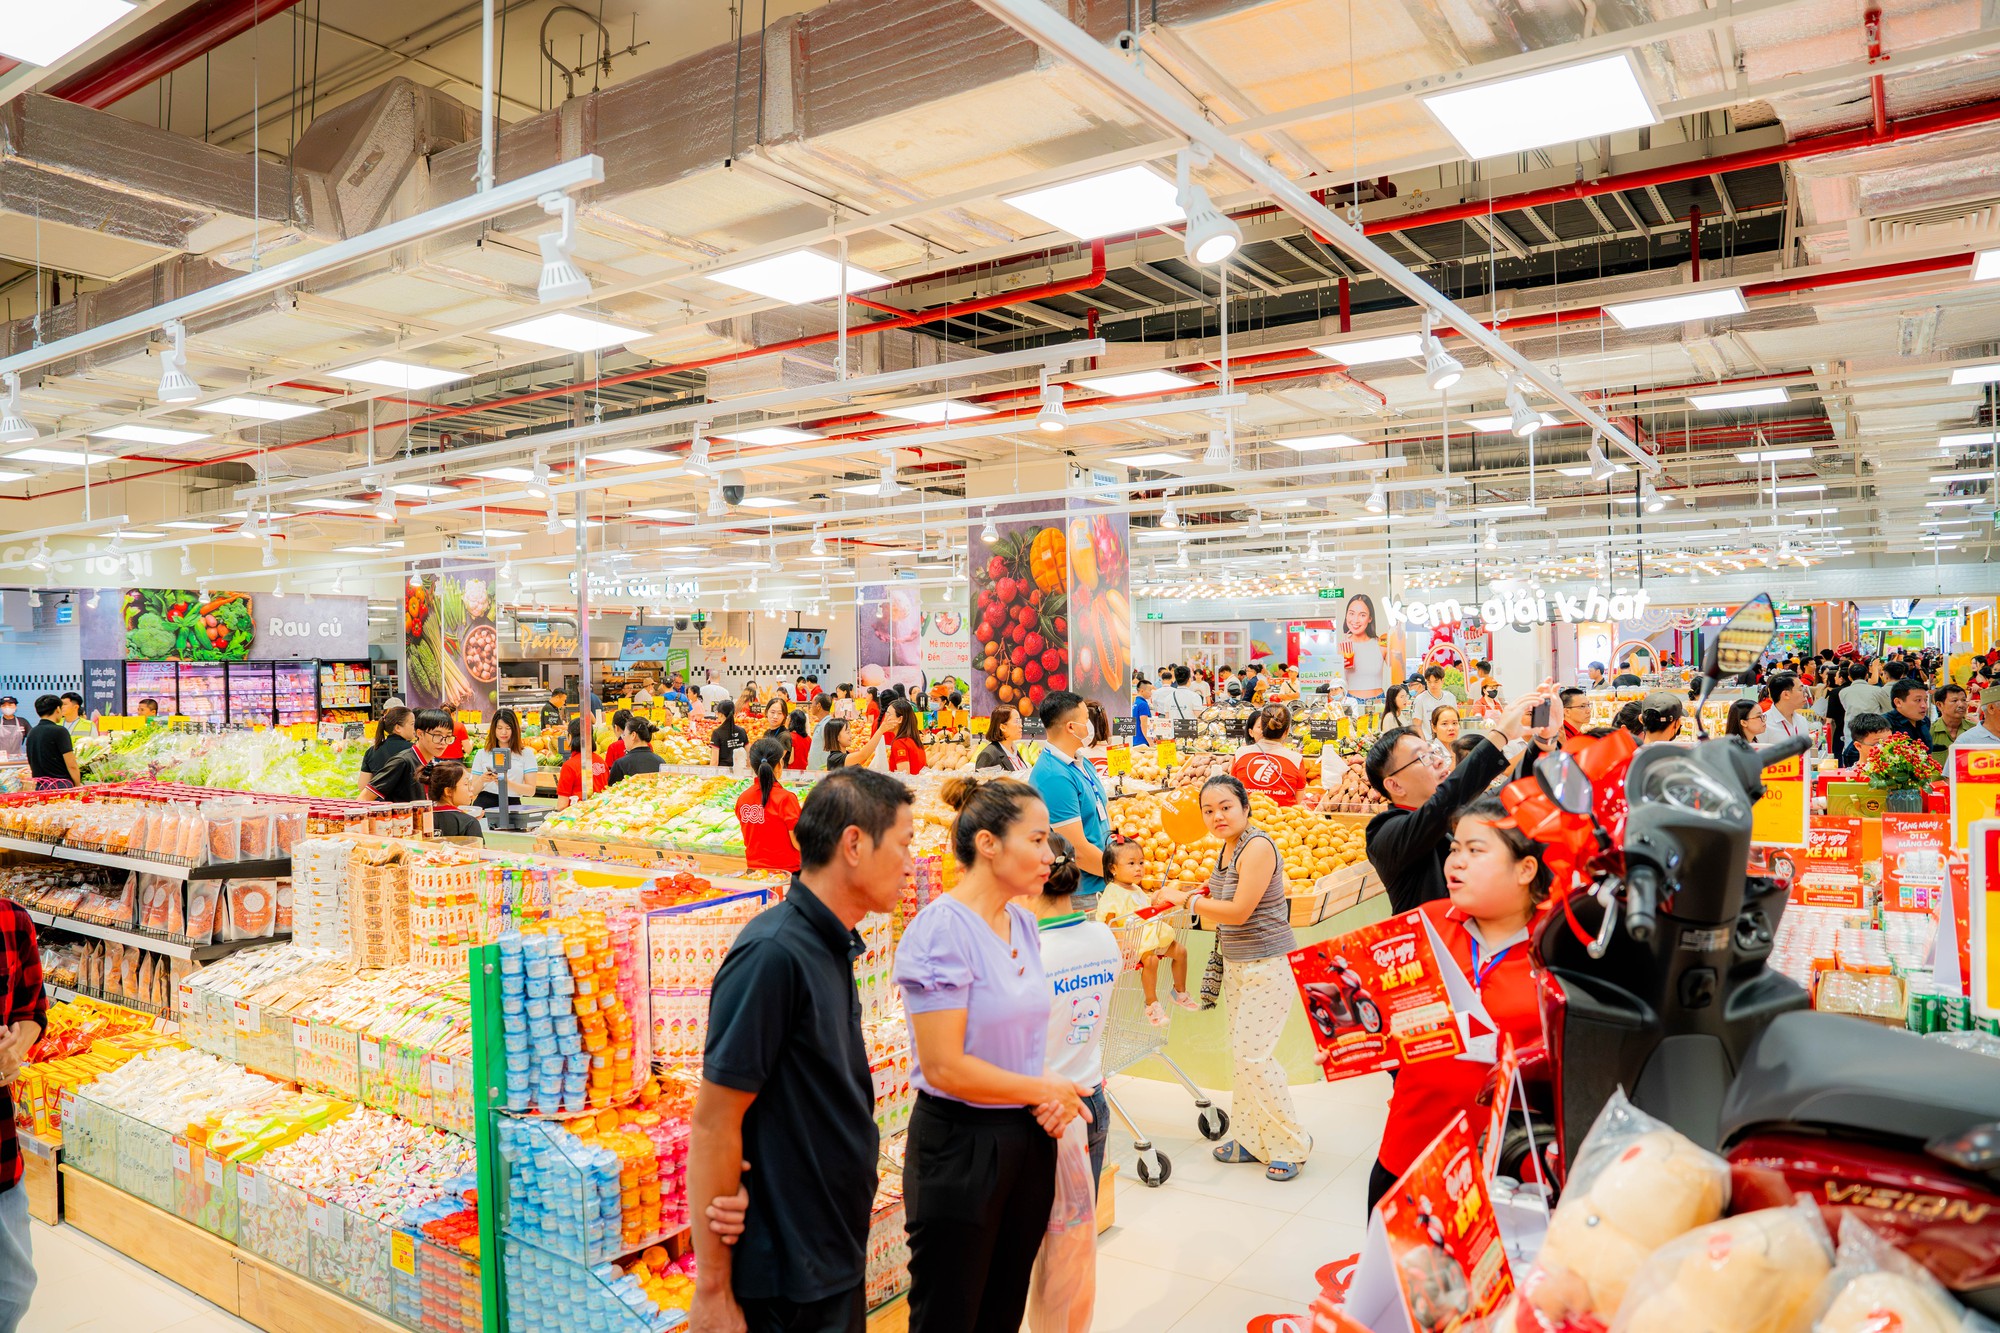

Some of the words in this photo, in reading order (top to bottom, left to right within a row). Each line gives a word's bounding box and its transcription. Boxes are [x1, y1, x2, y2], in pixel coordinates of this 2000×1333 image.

[269, 617, 311, 637] Rau
[318, 617, 342, 637] củ
[520, 624, 578, 658] Pastry
[700, 627, 749, 656] Bakery
[1253, 759, 1271, 781] 7
[1054, 968, 1114, 995] Kidsmix
[1825, 1180, 1991, 1224] VISION
